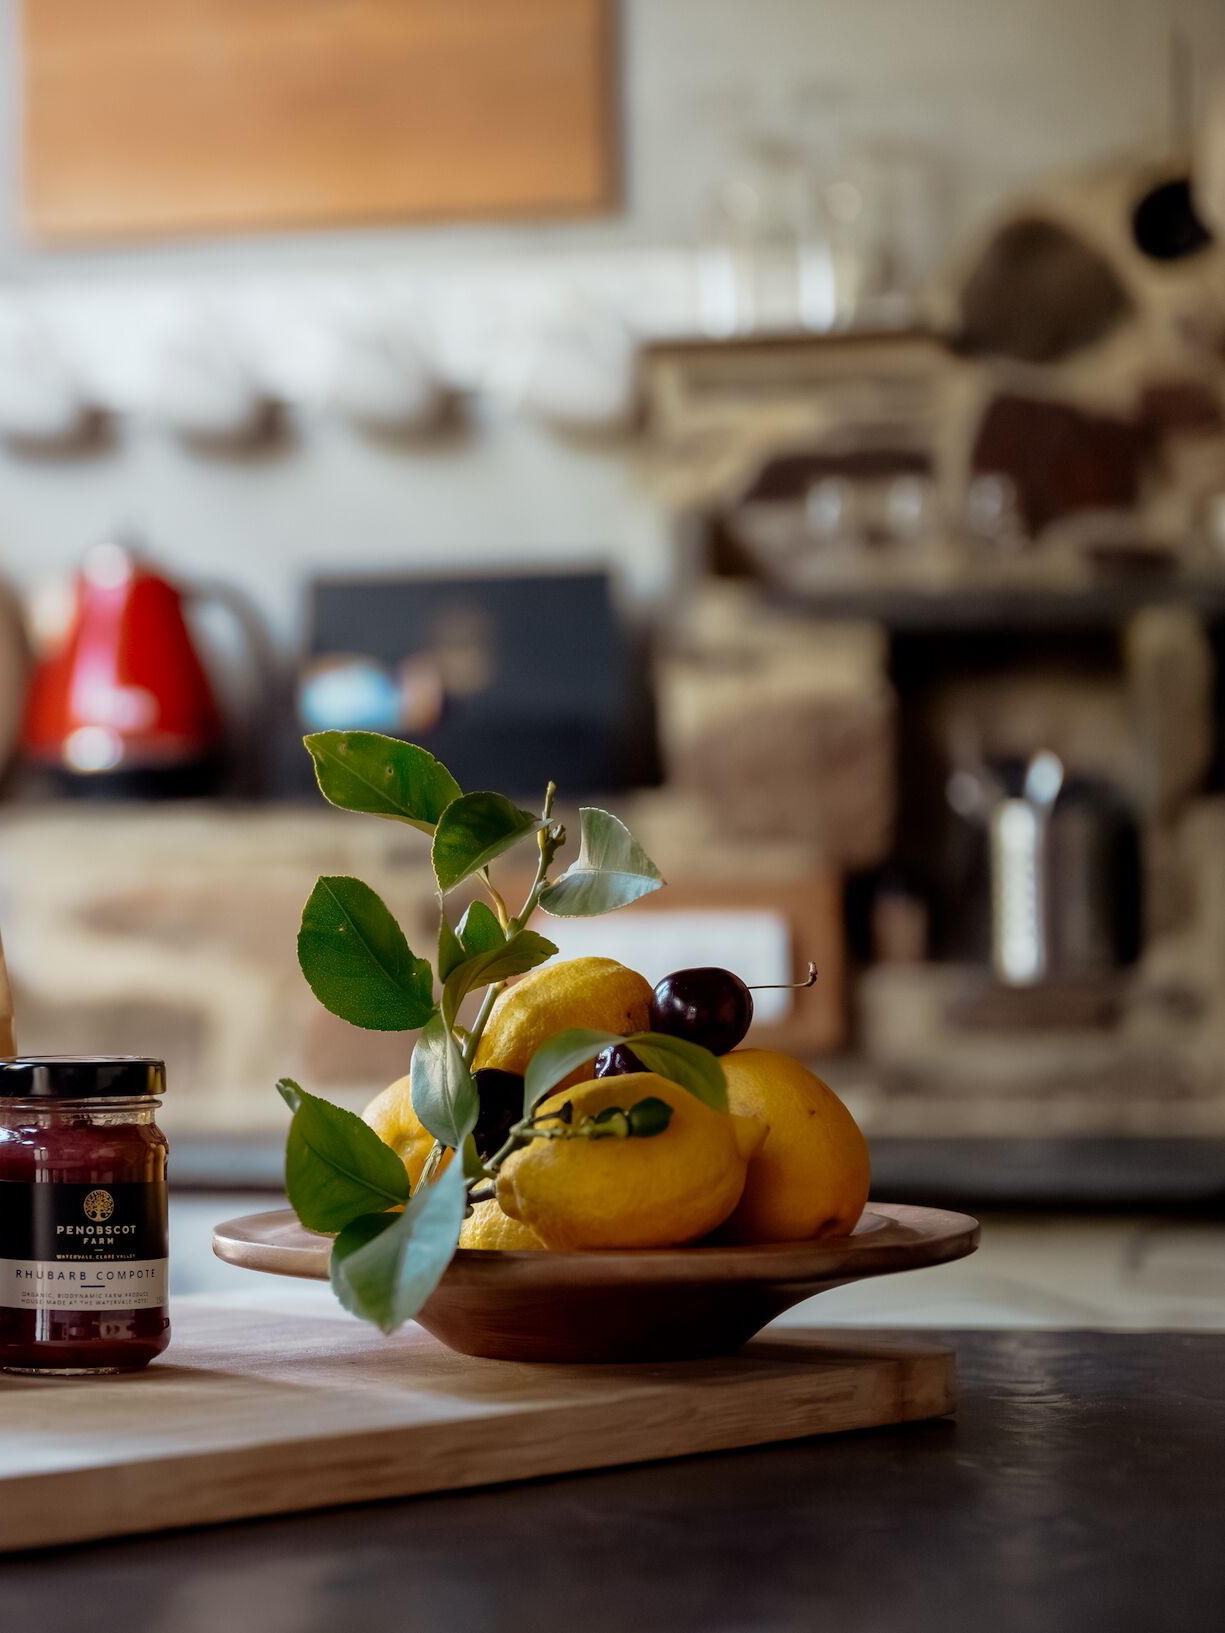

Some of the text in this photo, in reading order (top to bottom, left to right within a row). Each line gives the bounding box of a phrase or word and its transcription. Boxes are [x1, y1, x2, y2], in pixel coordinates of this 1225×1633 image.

[56, 1225, 136, 1235] PENOBSCOT
[16, 1268, 156, 1281] RHUBARB COMPOTE
